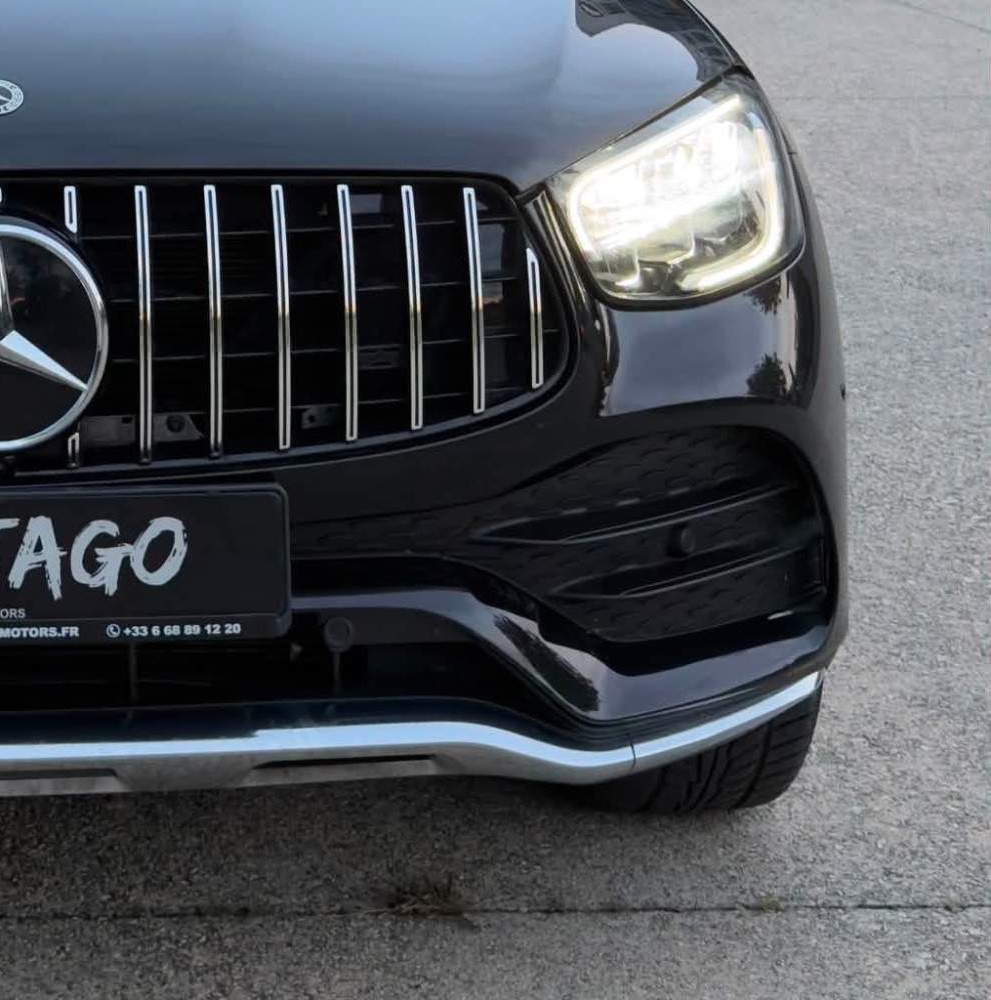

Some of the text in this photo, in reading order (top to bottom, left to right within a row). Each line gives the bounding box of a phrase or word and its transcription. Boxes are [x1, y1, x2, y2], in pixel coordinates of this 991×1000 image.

[123, 623, 241, 637] +33 6 68 89 12 20
